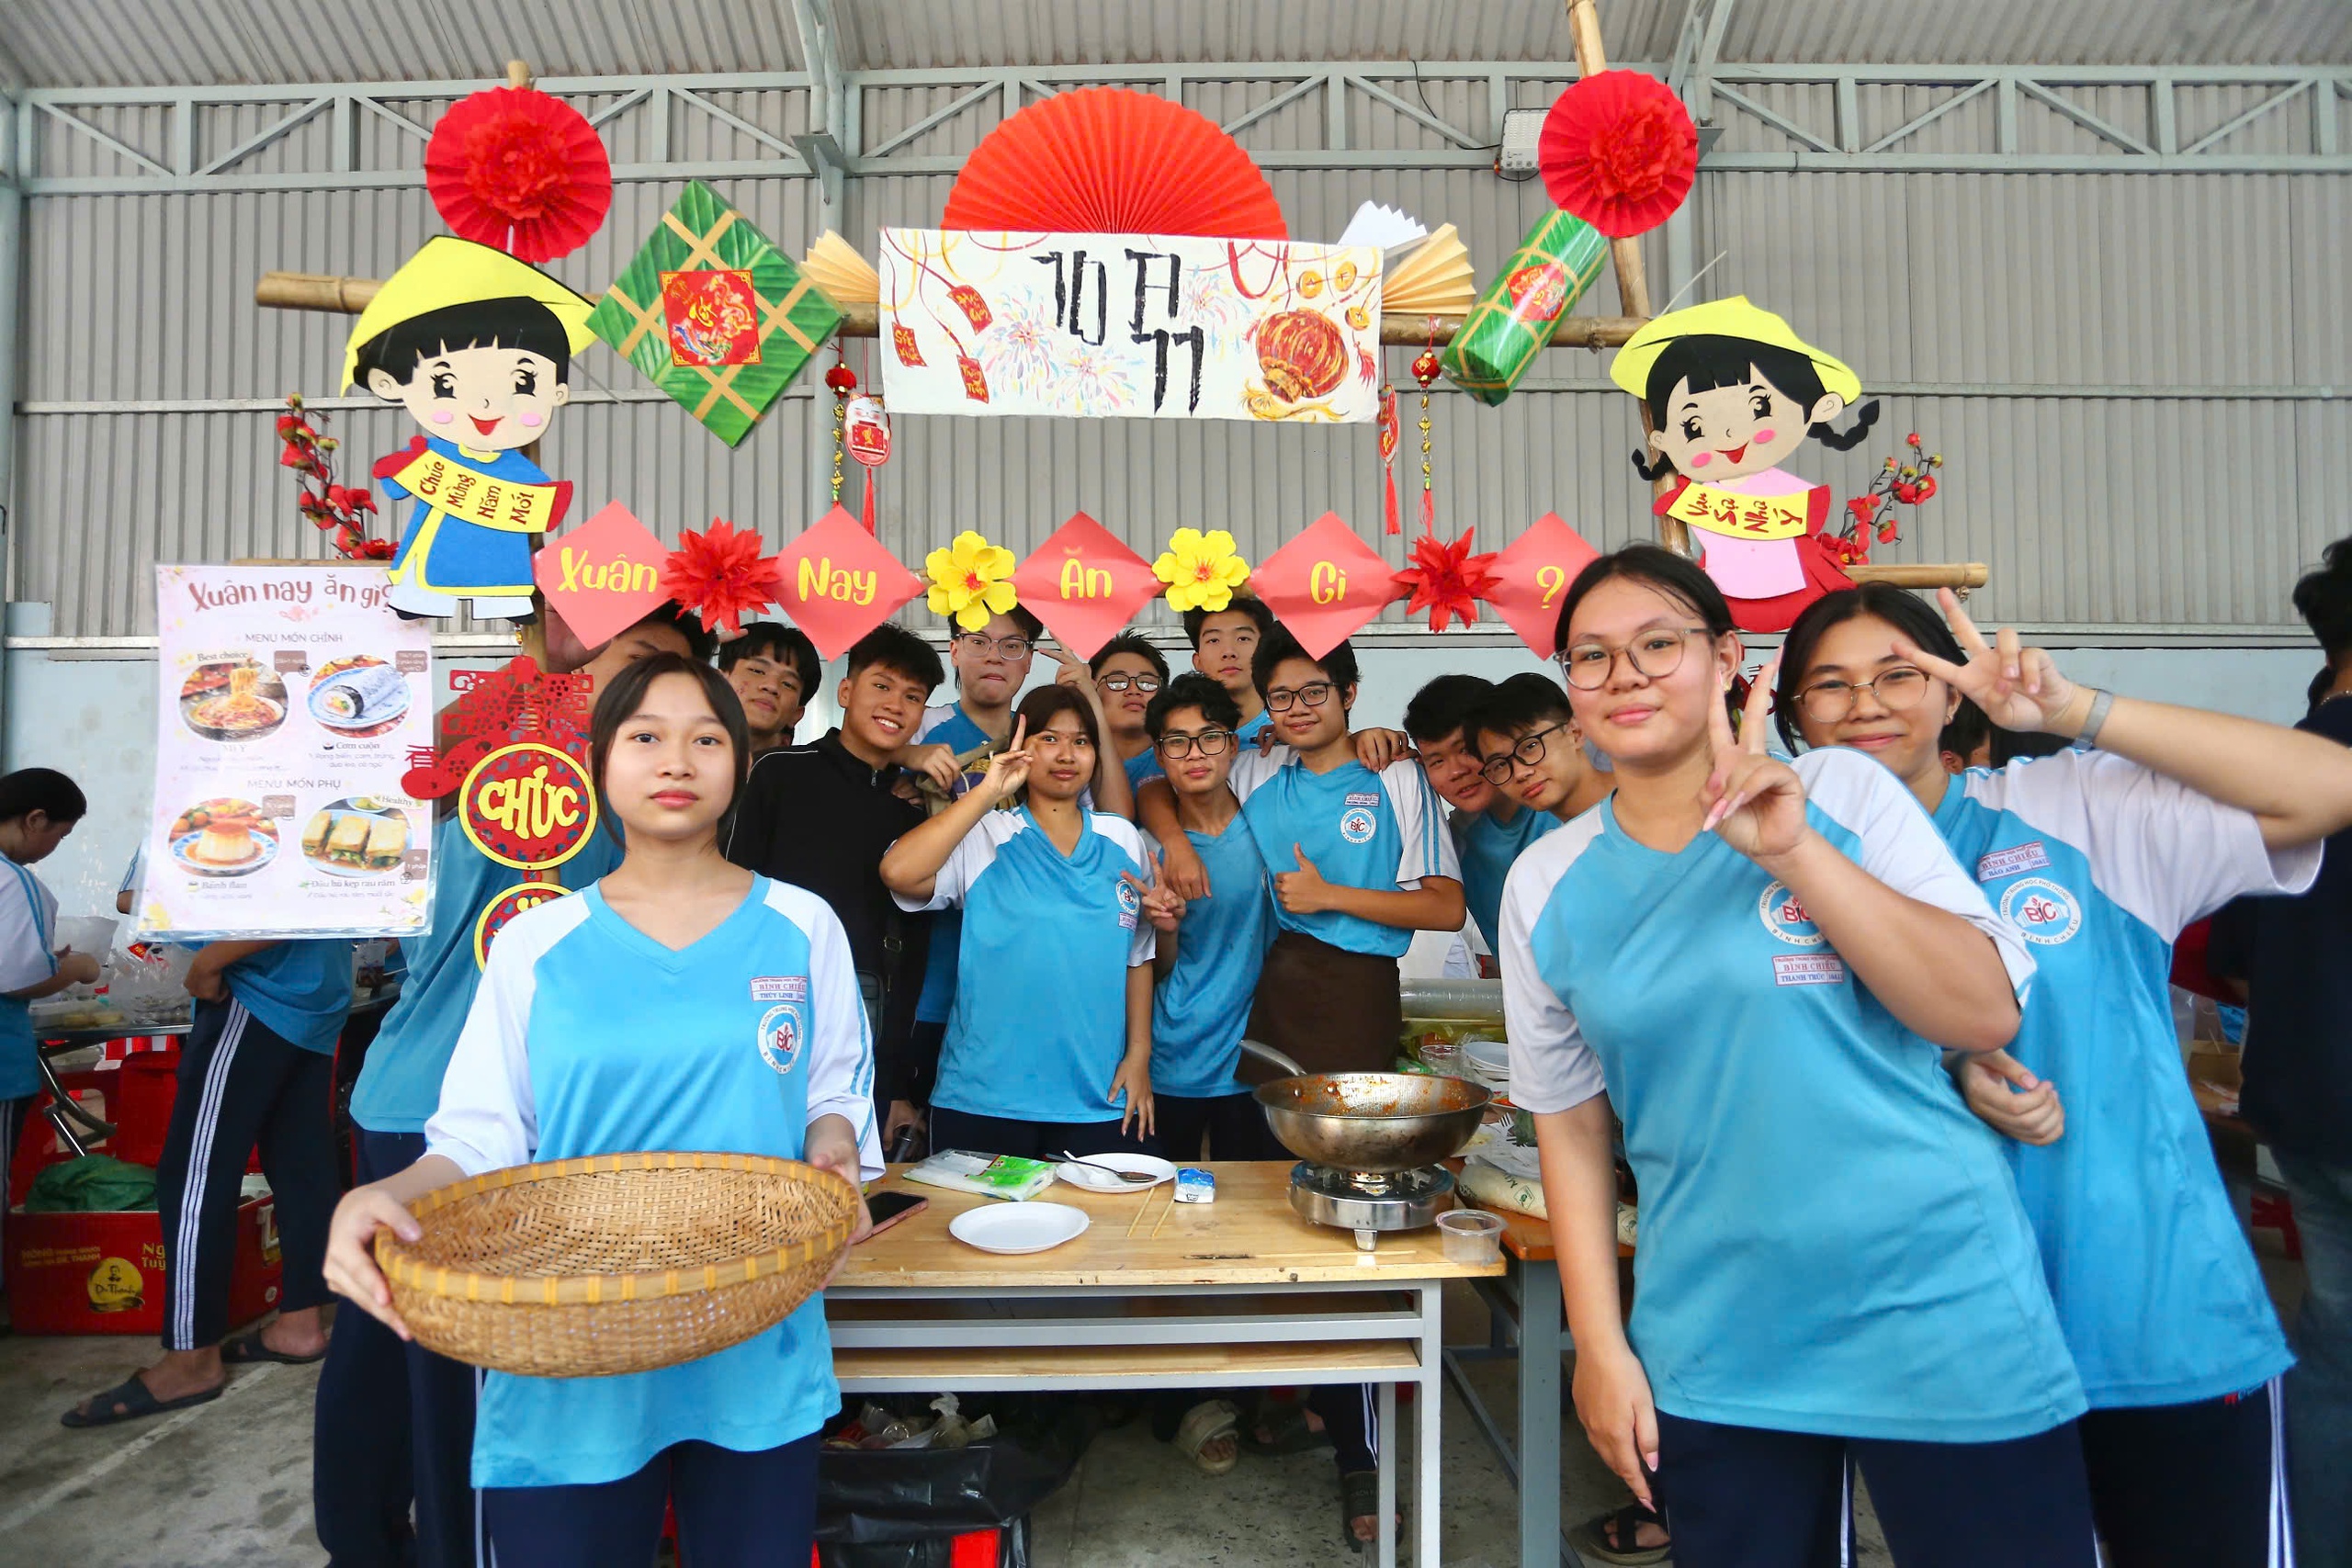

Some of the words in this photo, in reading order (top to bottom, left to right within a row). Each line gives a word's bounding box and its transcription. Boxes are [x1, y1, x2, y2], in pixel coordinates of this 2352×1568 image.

[446, 473, 477, 509] Mừng
[477, 485, 502, 520] Năm
[509, 491, 535, 525] Mới
[1713, 498, 1739, 526] Sự
[1744, 500, 1770, 534] Như
[1772, 507, 1804, 526] Ý
[557, 546, 659, 593] Xuân
[797, 557, 877, 606] Nay
[1059, 544, 1114, 601] Ăn
[1310, 560, 1347, 604] Gì
[1534, 565, 1566, 610] ?
[188, 579, 257, 612] Xuân
[262, 580, 312, 604] nay
[324, 573, 356, 603] ăn
[245, 634, 277, 643] MENU
[281, 632, 307, 643] MÓN
[311, 632, 343, 643] CHÍNH
[197, 652, 219, 662] Best
[220, 651, 249, 660] choice
[246, 780, 282, 789] MENU
[287, 777, 314, 789] MÓN
[318, 780, 341, 790] PHỤ
[381, 795, 413, 807] Healthy
[477, 764, 581, 840] CHÚC
[2005, 864, 2020, 874] ANH
[1781, 974, 1806, 983] THANH
